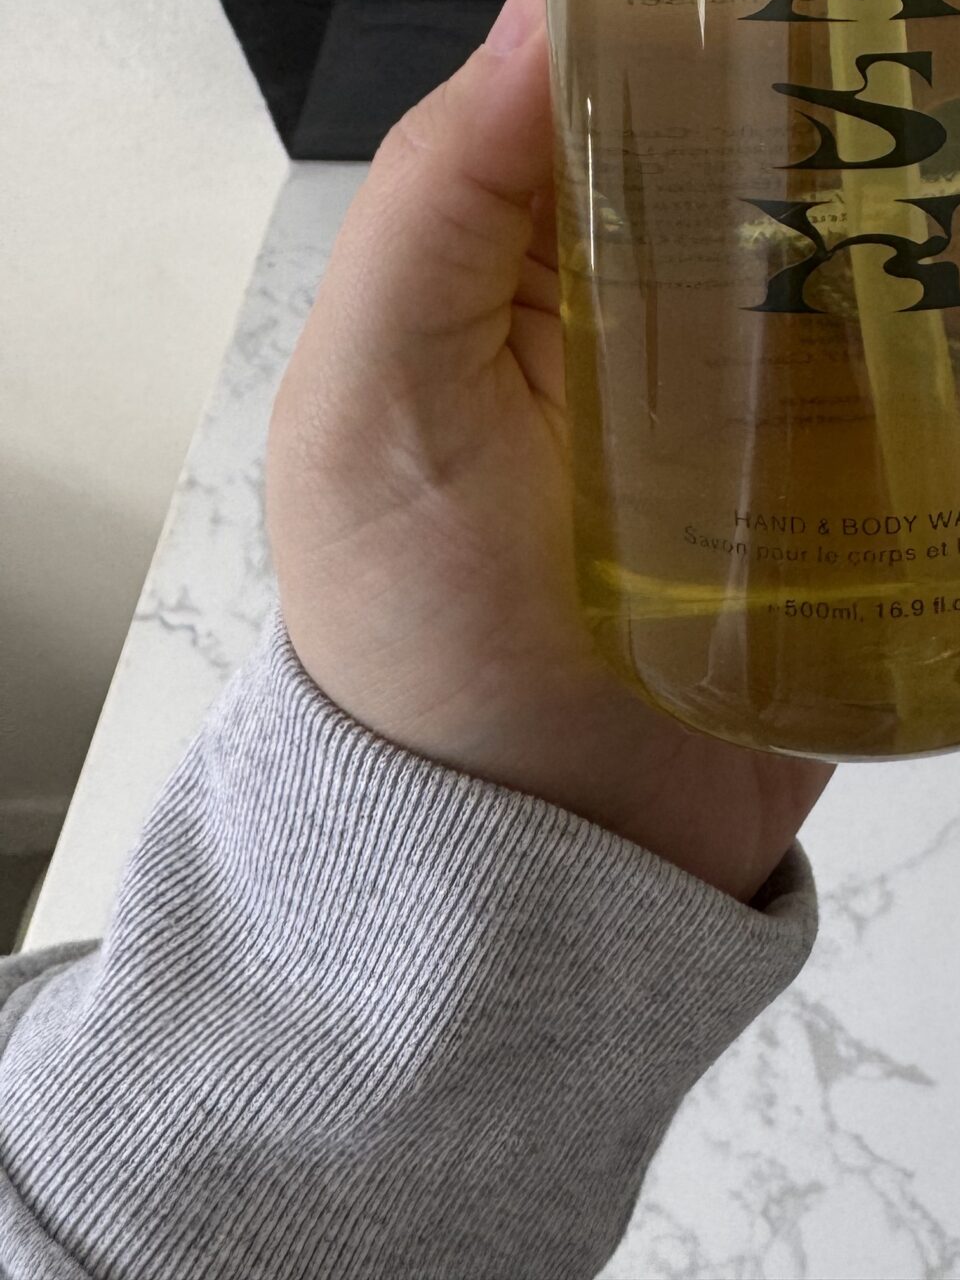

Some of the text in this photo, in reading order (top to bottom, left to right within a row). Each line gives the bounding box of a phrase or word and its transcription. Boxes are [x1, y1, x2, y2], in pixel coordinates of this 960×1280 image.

[734, 508, 807, 535] HAND
[817, 517, 831, 536] &
[842, 514, 918, 537] BODY
[683, 524, 748, 556] Savon
[925, 541, 949, 560] et
[875, 598, 925, 620] 16.9
